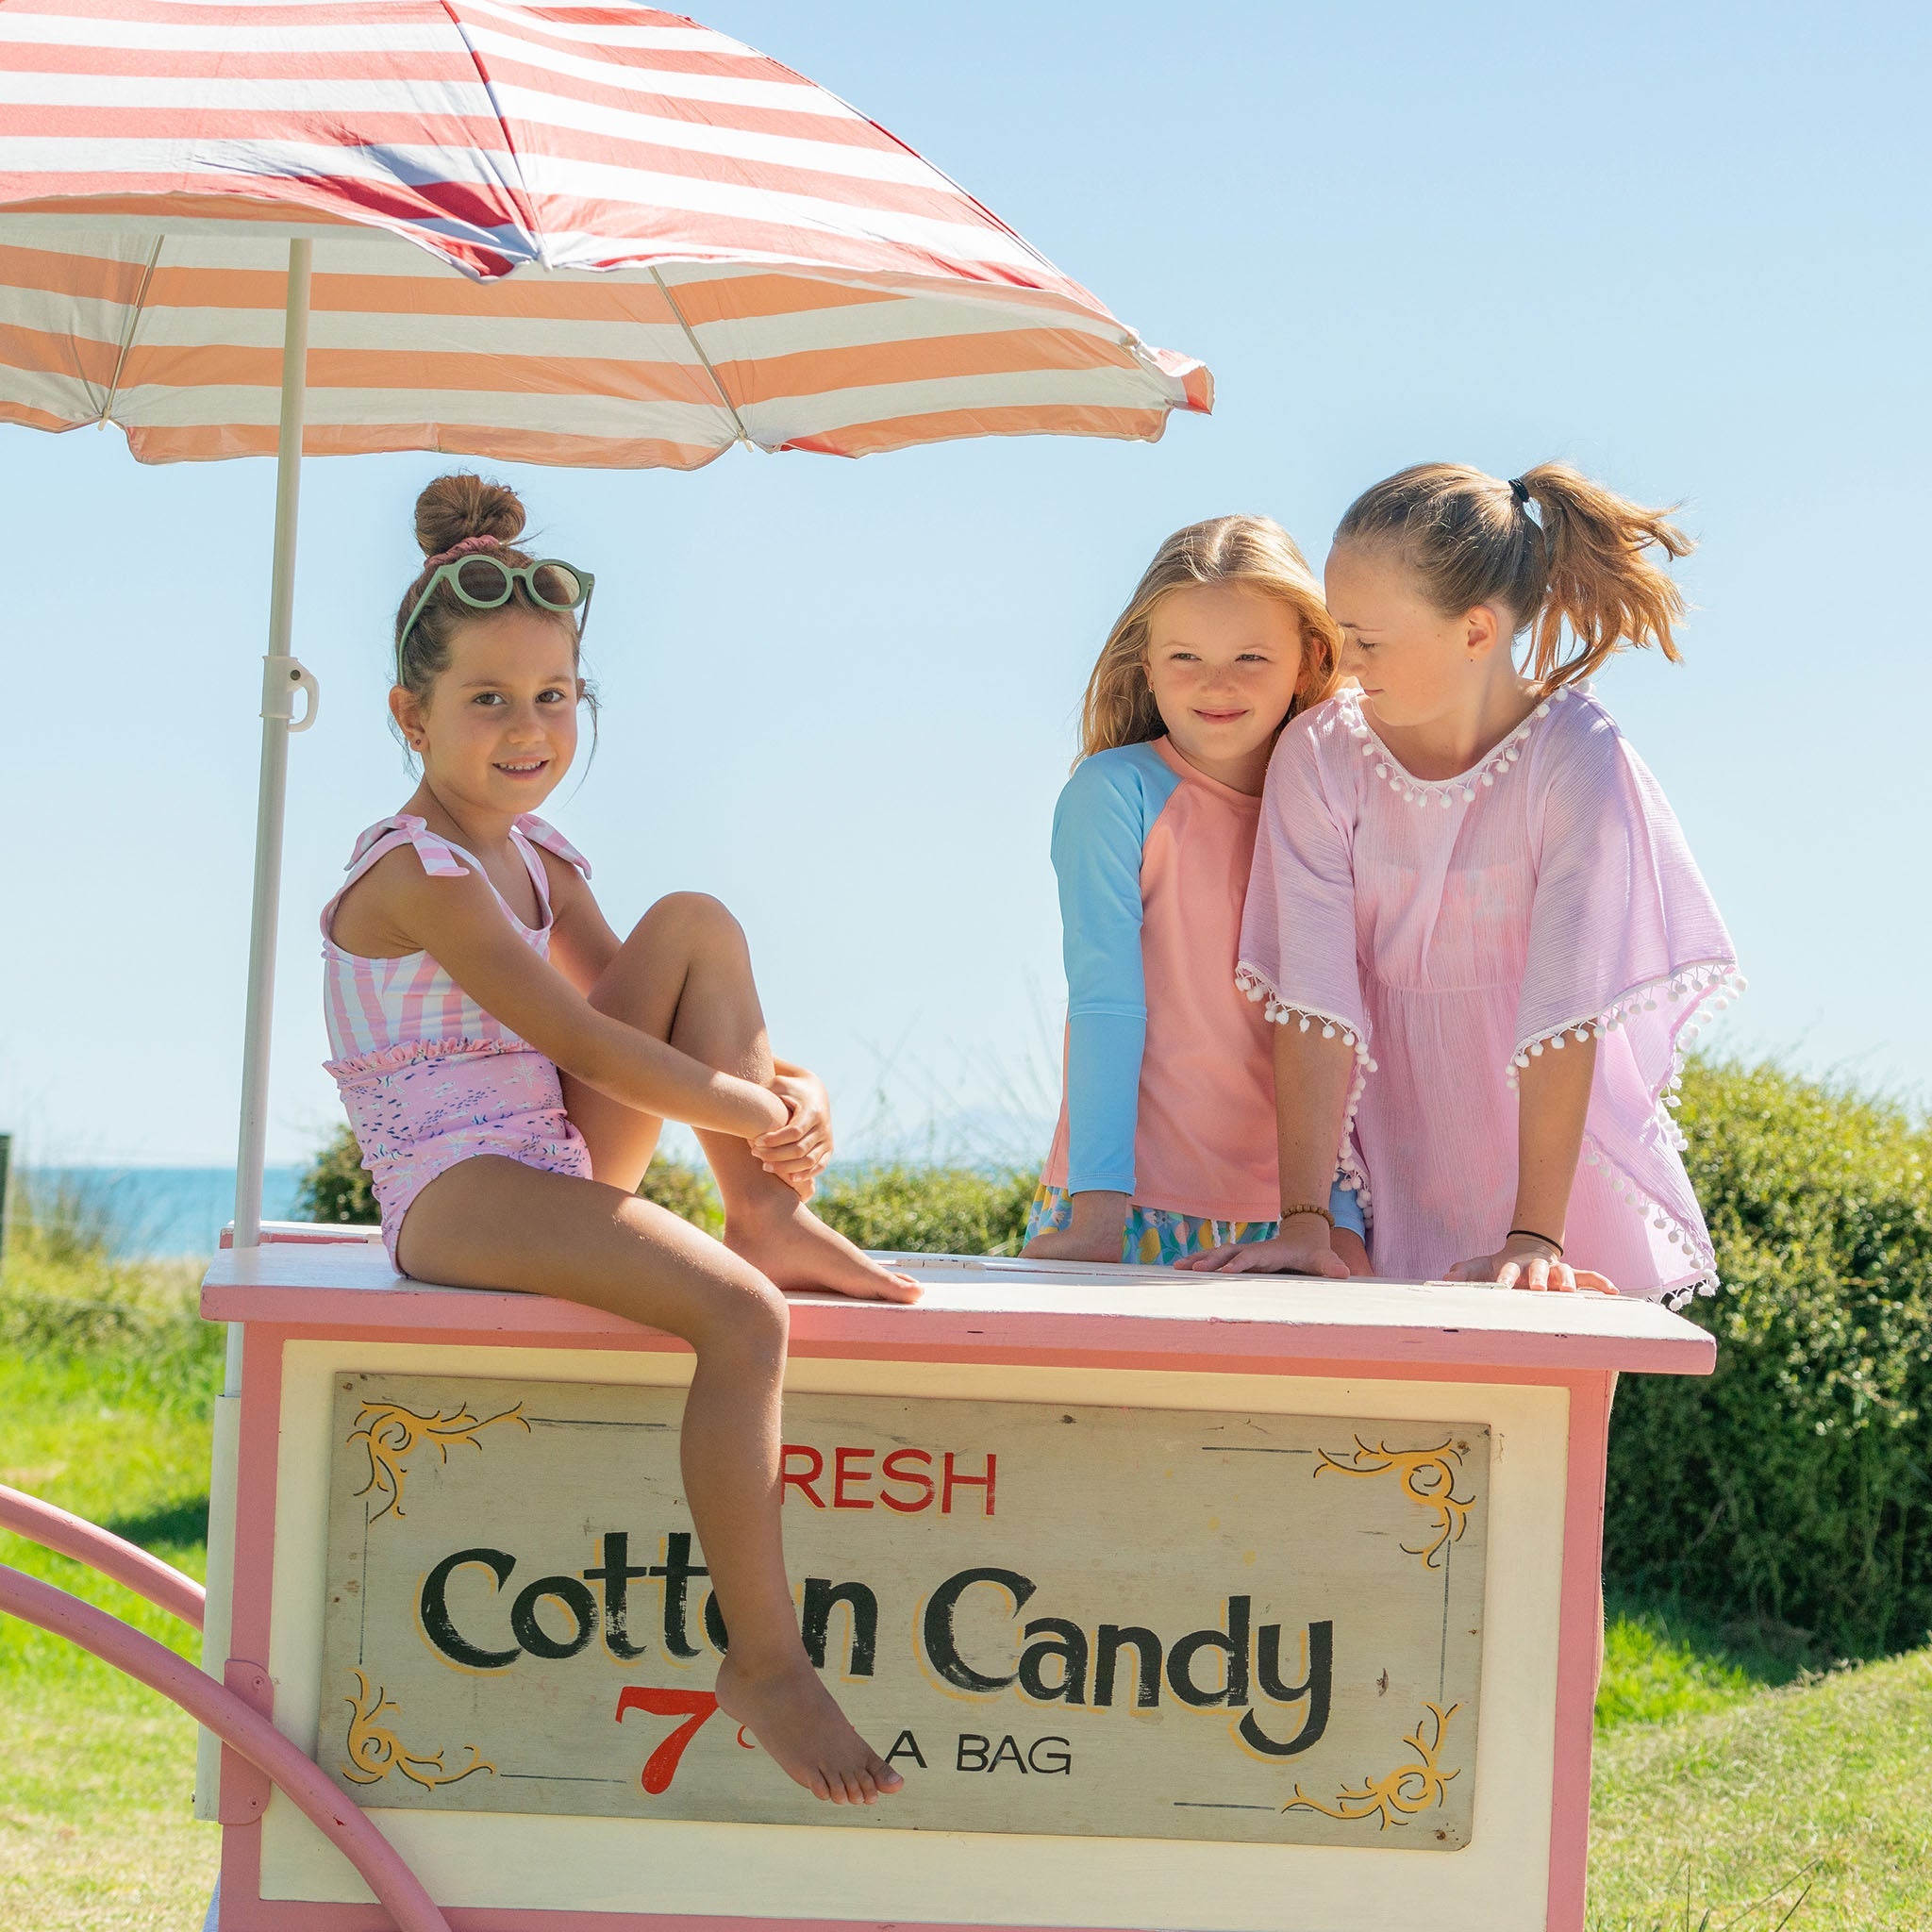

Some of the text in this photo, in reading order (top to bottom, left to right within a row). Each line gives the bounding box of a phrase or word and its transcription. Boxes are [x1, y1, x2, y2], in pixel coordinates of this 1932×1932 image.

[780, 1444, 997, 1516] RESH
[420, 1530, 1334, 1757] Cottn Candy
[615, 1685, 721, 1795] 7
[884, 1729, 928, 1769] A
[956, 1733, 1073, 1775] BAG
